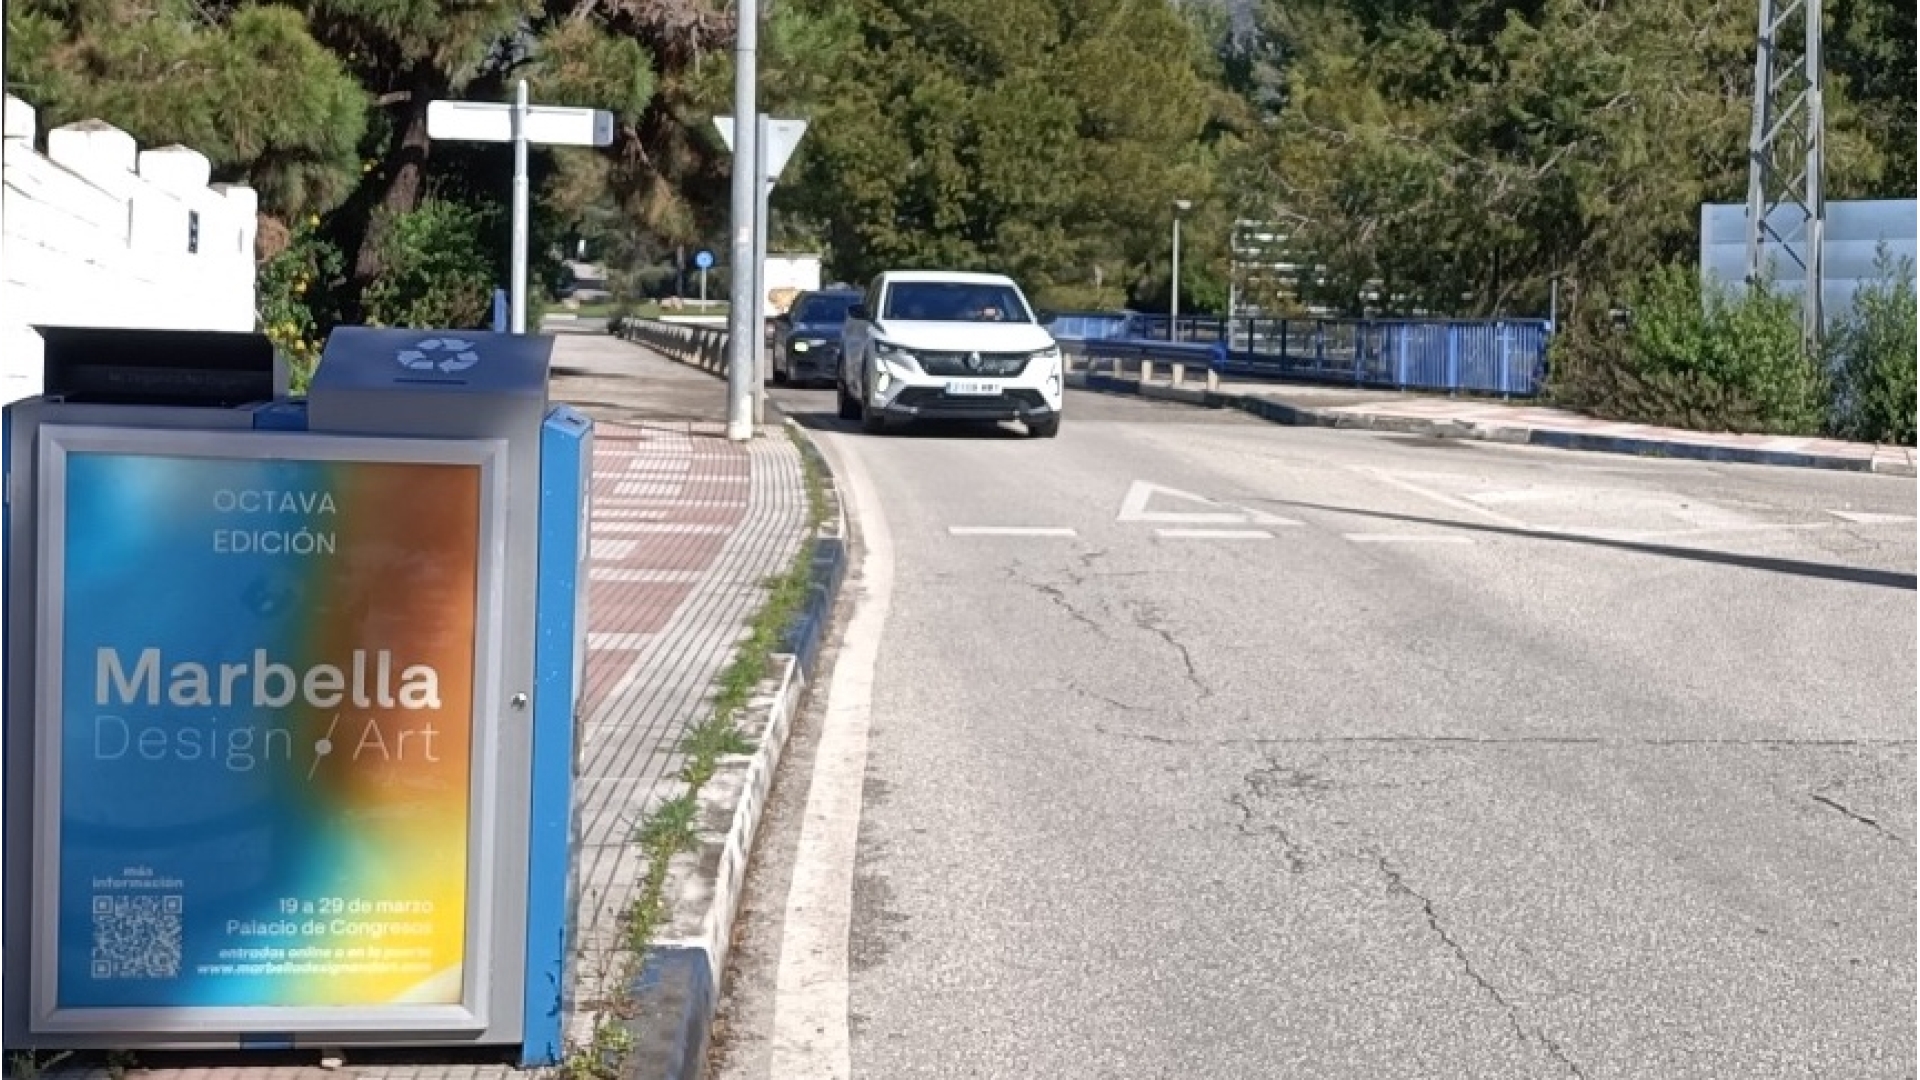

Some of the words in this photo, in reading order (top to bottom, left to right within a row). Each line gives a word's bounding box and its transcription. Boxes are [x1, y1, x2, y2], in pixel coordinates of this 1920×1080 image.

[213, 489, 337, 515] OCTAVA
[213, 526, 337, 555] EDICIÓN
[94, 647, 442, 710] Marbella
[93, 714, 293, 772] Design
[352, 717, 441, 763] Art
[279, 897, 299, 914] 19
[302, 901, 315, 914] a
[318, 897, 344, 914] 29
[348, 897, 373, 914] de
[376, 900, 434, 915] marzo
[225, 919, 298, 936] Palacio
[301, 919, 326, 935] de
[330, 918, 434, 940] Congresos
